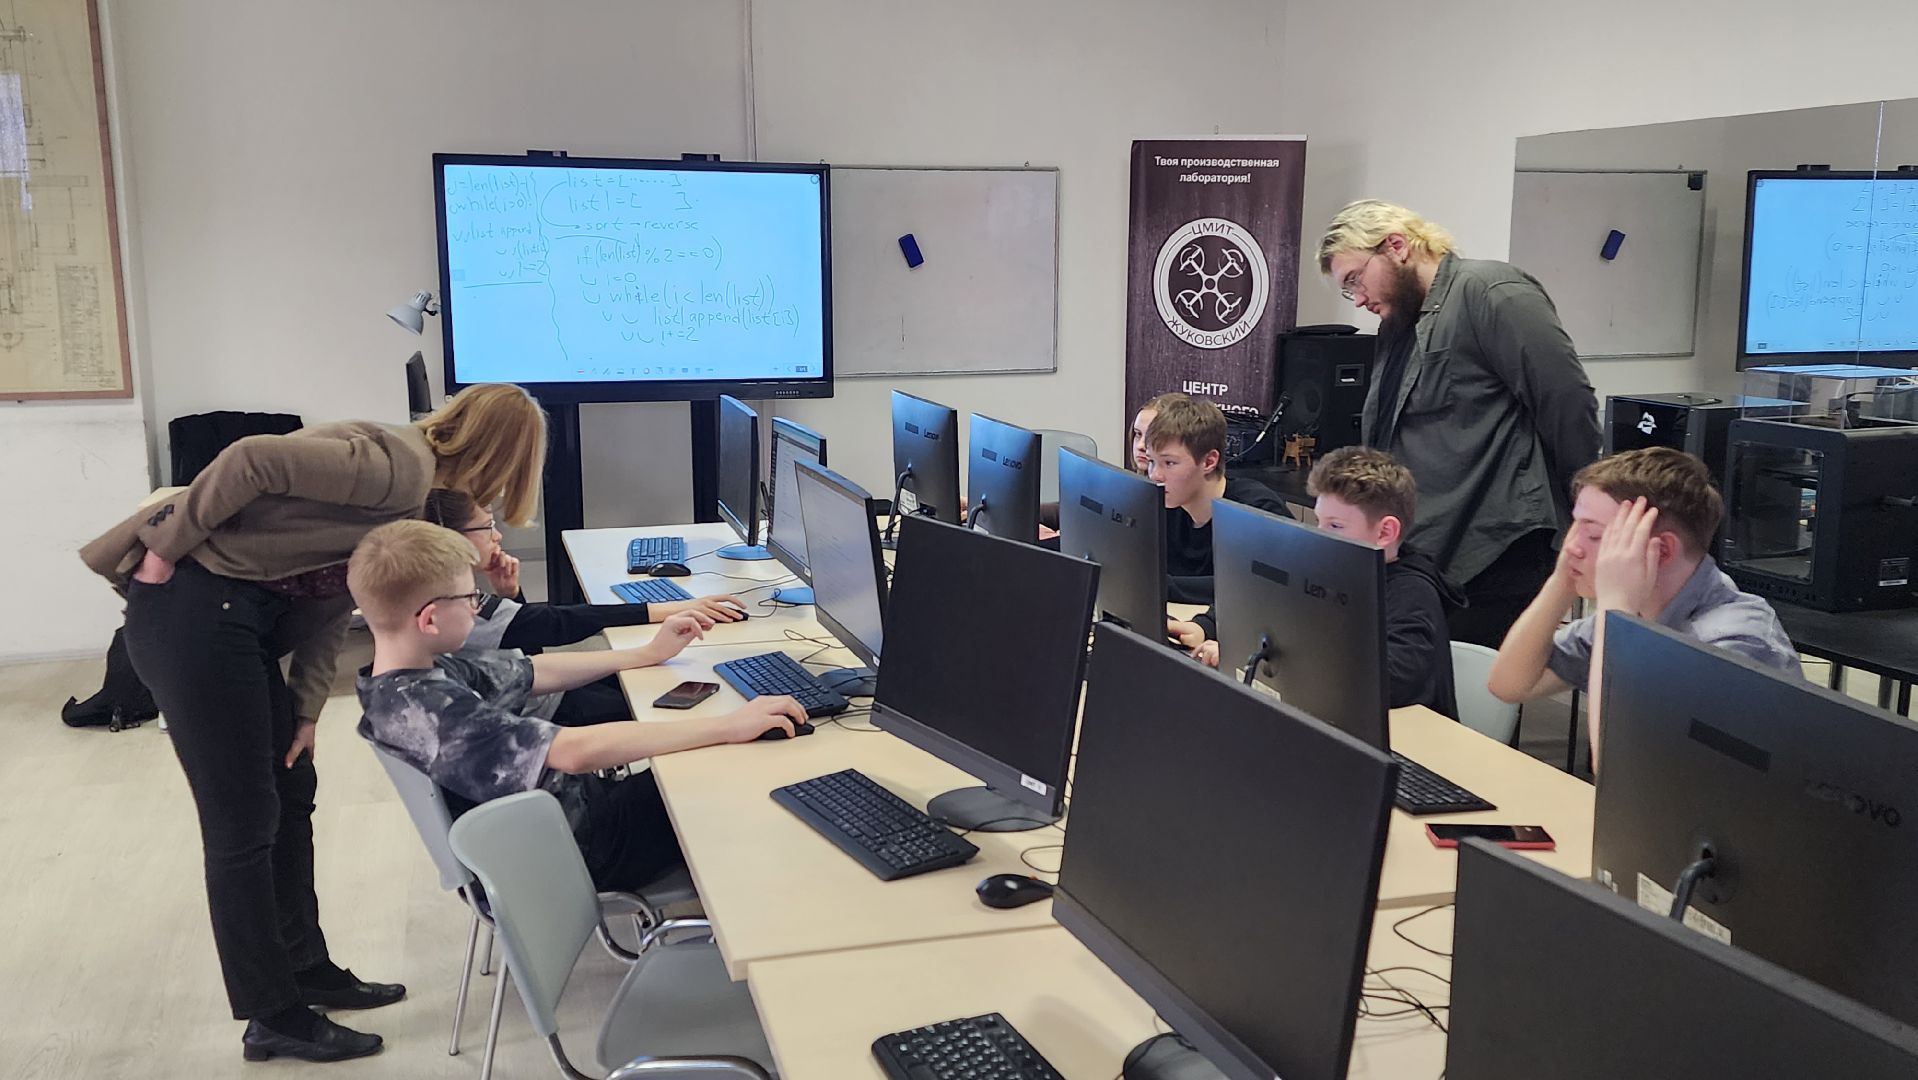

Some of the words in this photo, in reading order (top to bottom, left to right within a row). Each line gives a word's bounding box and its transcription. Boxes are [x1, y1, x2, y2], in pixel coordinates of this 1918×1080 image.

[1154, 156, 1179, 166] Твоя
[1180, 158, 1280, 168] производственная
[1179, 172, 1251, 184] лаборатория!
[1191, 222, 1234, 236] ЦМИТ
[1167, 316, 1252, 346] ЖУКОВСКИЙ
[1182, 380, 1229, 396] ЦЕНТР
[1304, 577, 1349, 606] Lenvo
